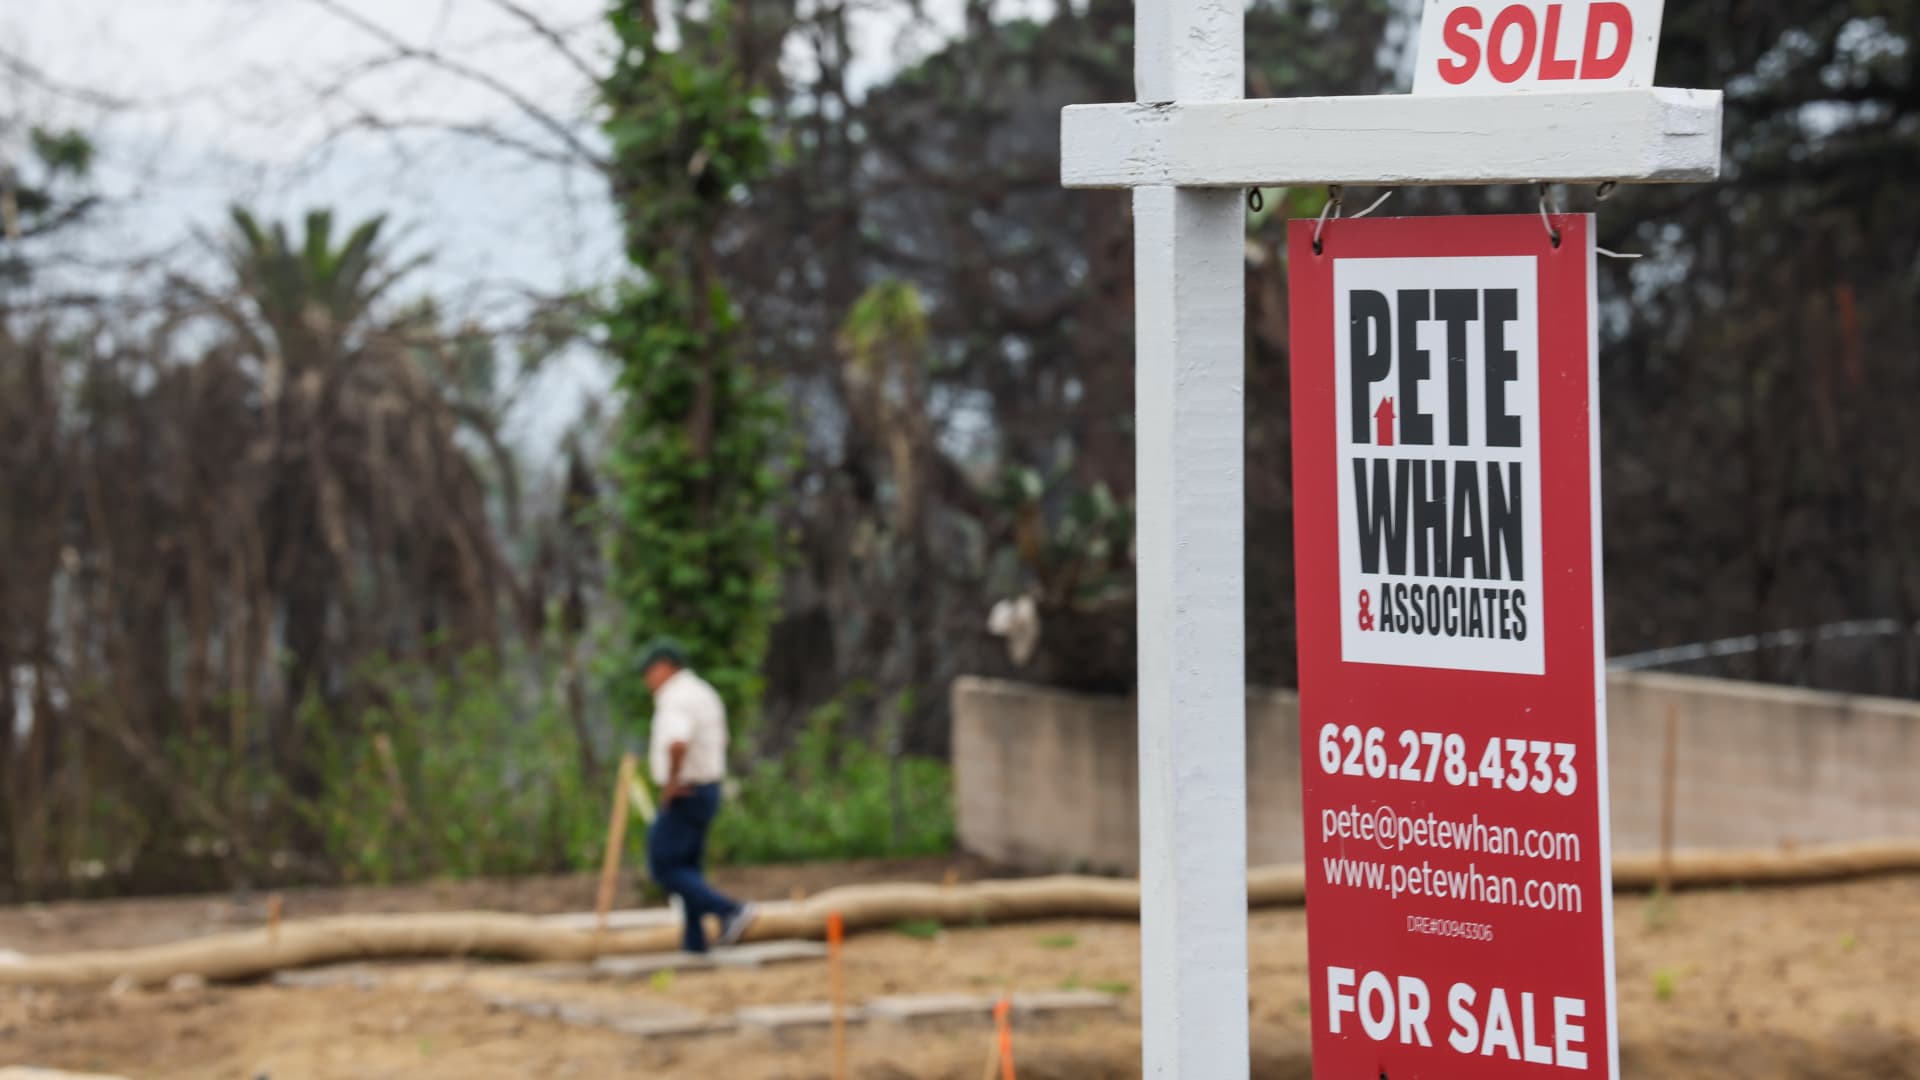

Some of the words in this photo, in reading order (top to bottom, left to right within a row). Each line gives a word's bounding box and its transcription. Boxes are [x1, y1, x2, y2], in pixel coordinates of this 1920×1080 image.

[1437, 2, 1634, 85] SOLD
[1349, 288, 1522, 448] PETE
[1352, 457, 1524, 581] WHAN
[1357, 588, 1375, 632] &
[1379, 582, 1527, 642] ASSOCIATES
[1318, 722, 1578, 796] 626.278.4333
[1321, 804, 1581, 862] pete@petewhan.com
[1322, 856, 1583, 913] www.petewhan.com
[1326, 965, 1433, 1048] FOR
[1447, 981, 1589, 1070] SALE
